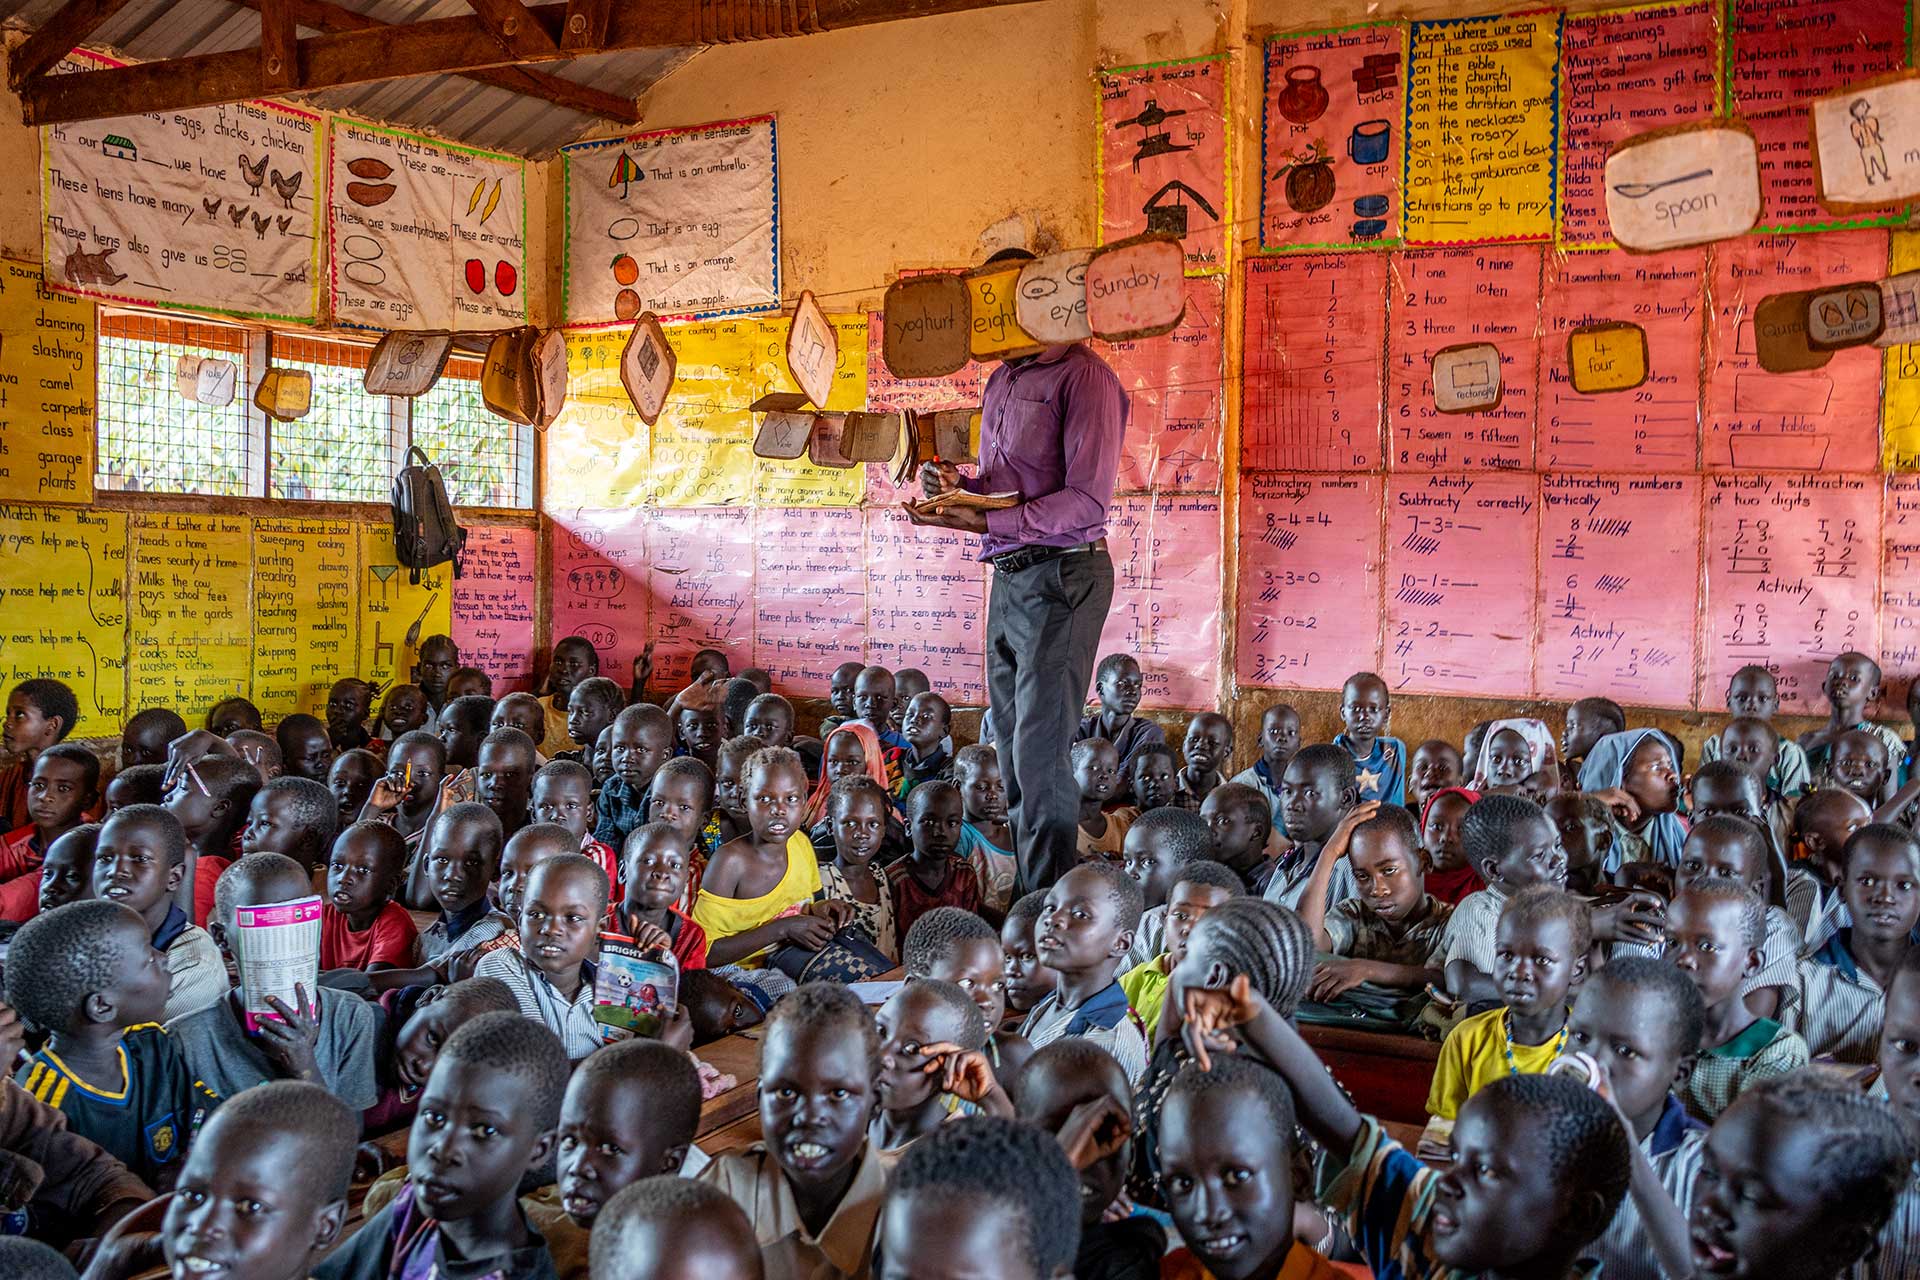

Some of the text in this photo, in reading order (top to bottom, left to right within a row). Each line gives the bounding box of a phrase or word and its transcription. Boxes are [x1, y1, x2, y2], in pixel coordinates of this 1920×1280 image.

[1684, 3, 1708, 15] and
[1454, 21, 1536, 40] where we can
[1604, 25, 1664, 44] meanings
[1470, 34, 1532, 52] cross used
[1618, 50, 1652, 63] means
[1658, 42, 1707, 59] blessing
[1416, 57, 1459, 75] on the
[1438, 70, 1457, 84] the
[1617, 69, 1685, 91] means gift
[1466, 76, 1511, 99] hospital
[1358, 88, 1394, 106] bricks
[1415, 110, 1525, 130] on the necklaces
[1630, 105, 1667, 118] means
[691, 133, 698, 142] in
[1186, 124, 1206, 144] tap
[1290, 123, 1309, 137] pot
[1442, 128, 1518, 146] the rosary
[262, 129, 304, 154] chicken
[424, 147, 439, 157] are
[1416, 144, 1518, 169] on the first aid
[200, 158, 226, 180] have
[397, 153, 445, 176] These are
[650, 167, 703, 180] That is an
[1366, 164, 1389, 180] cup
[1441, 170, 1462, 184] the
[49, 169, 195, 226] These hens have many
[1444, 183, 1484, 200] Activity
[1479, 198, 1548, 216] go to pray
[332, 206, 384, 230] These are
[1272, 212, 1332, 232] flower vase
[687, 224, 698, 232] an
[93, 227, 208, 268] hens also give us
[646, 263, 668, 273] That
[1252, 260, 1346, 278] Number symbols
[1426, 269, 1446, 278] one
[1489, 259, 1514, 271] nine
[1092, 264, 1160, 299] Sunday
[1489, 283, 1508, 297] ten
[980, 283, 996, 304] 8
[1425, 290, 1447, 305] two
[974, 300, 1018, 342] eight
[1051, 299, 1086, 328] eye
[1656, 303, 1695, 322] twenty
[35, 309, 85, 343] dancing
[893, 305, 954, 344] yoghurt
[1406, 320, 1456, 335] 3 three
[32, 336, 83, 370] slashing
[1594, 337, 1612, 356] 4
[1588, 359, 1615, 374] four
[40, 373, 74, 390] camel
[41, 398, 92, 421] carpenter
[42, 421, 73, 437] class
[1481, 426, 1519, 444] fifteen
[39, 451, 82, 473] garage
[39, 472, 76, 493] plants
[1322, 479, 1358, 489] numbers
[1429, 475, 1474, 495] Activity
[1543, 475, 1683, 495] Subtracting numbers
[1787, 478, 1864, 490] subtraction
[1179, 500, 1218, 512] numbers
[1476, 497, 1533, 515] correctly
[1735, 496, 1761, 506] two
[1772, 493, 1810, 511] digits
[0, 506, 61, 523] Match the
[162, 516, 169, 529] of
[176, 516, 201, 531] father
[222, 520, 241, 532] home
[255, 519, 293, 533] Activities
[9, 531, 78, 553] eyes help me
[139, 533, 207, 550] heads a home
[260, 534, 304, 552] sweeping
[318, 537, 345, 557] cooking
[104, 544, 124, 560] feel
[259, 549, 293, 572] writing
[257, 567, 296, 587] reading
[319, 557, 348, 579] drawing
[139, 572, 187, 587] Milks the
[10, 582, 58, 603] nose help
[258, 585, 293, 606] playing
[318, 580, 348, 599] praying
[1757, 577, 1813, 605] Activity
[257, 602, 297, 622] teaching
[368, 601, 390, 613] table
[257, 622, 297, 643] learning
[312, 616, 347, 638] modelling
[1570, 622, 1625, 650] Activity
[12, 634, 33, 644] ears
[370, 666, 391, 678] chair
[262, 686, 297, 704] dancing
[603, 945, 644, 958] BRIGHT
